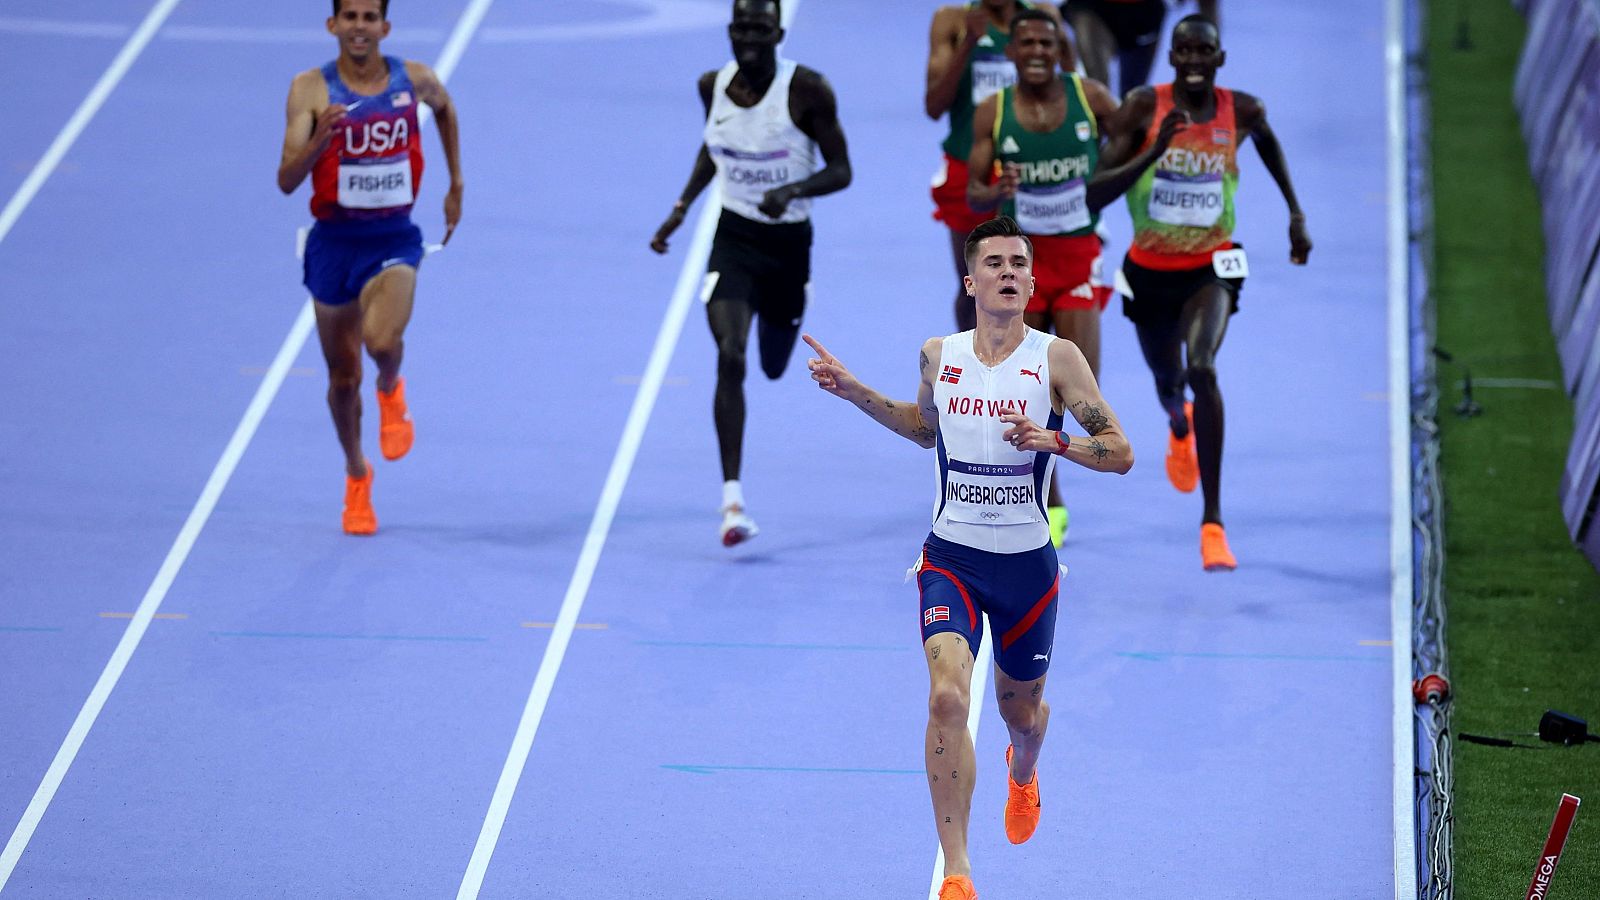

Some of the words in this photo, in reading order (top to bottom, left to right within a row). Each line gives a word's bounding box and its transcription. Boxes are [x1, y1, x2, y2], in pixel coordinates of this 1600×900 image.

[345, 117, 409, 154] USA
[1157, 147, 1226, 175] KENYA
[348, 172, 405, 192] FISHER
[1222, 257, 1242, 271] 21
[968, 465, 990, 473] PARIS
[947, 481, 1033, 505] INGEBRIGTSEN
